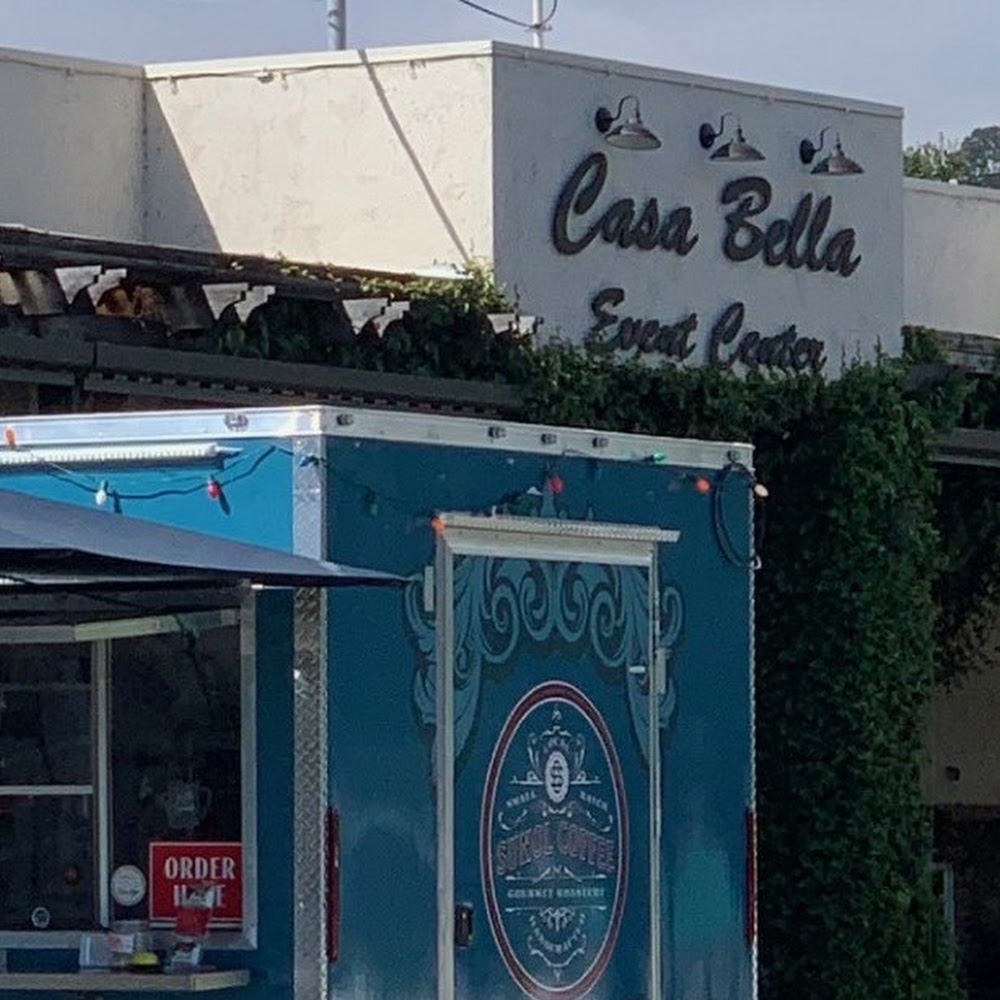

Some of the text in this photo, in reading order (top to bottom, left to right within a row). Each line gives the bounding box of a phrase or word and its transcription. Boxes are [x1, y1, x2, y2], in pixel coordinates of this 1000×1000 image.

[553, 152, 862, 277] Casa Bella
[586, 288, 827, 371] Event Center
[165, 856, 236, 880] ORDER
